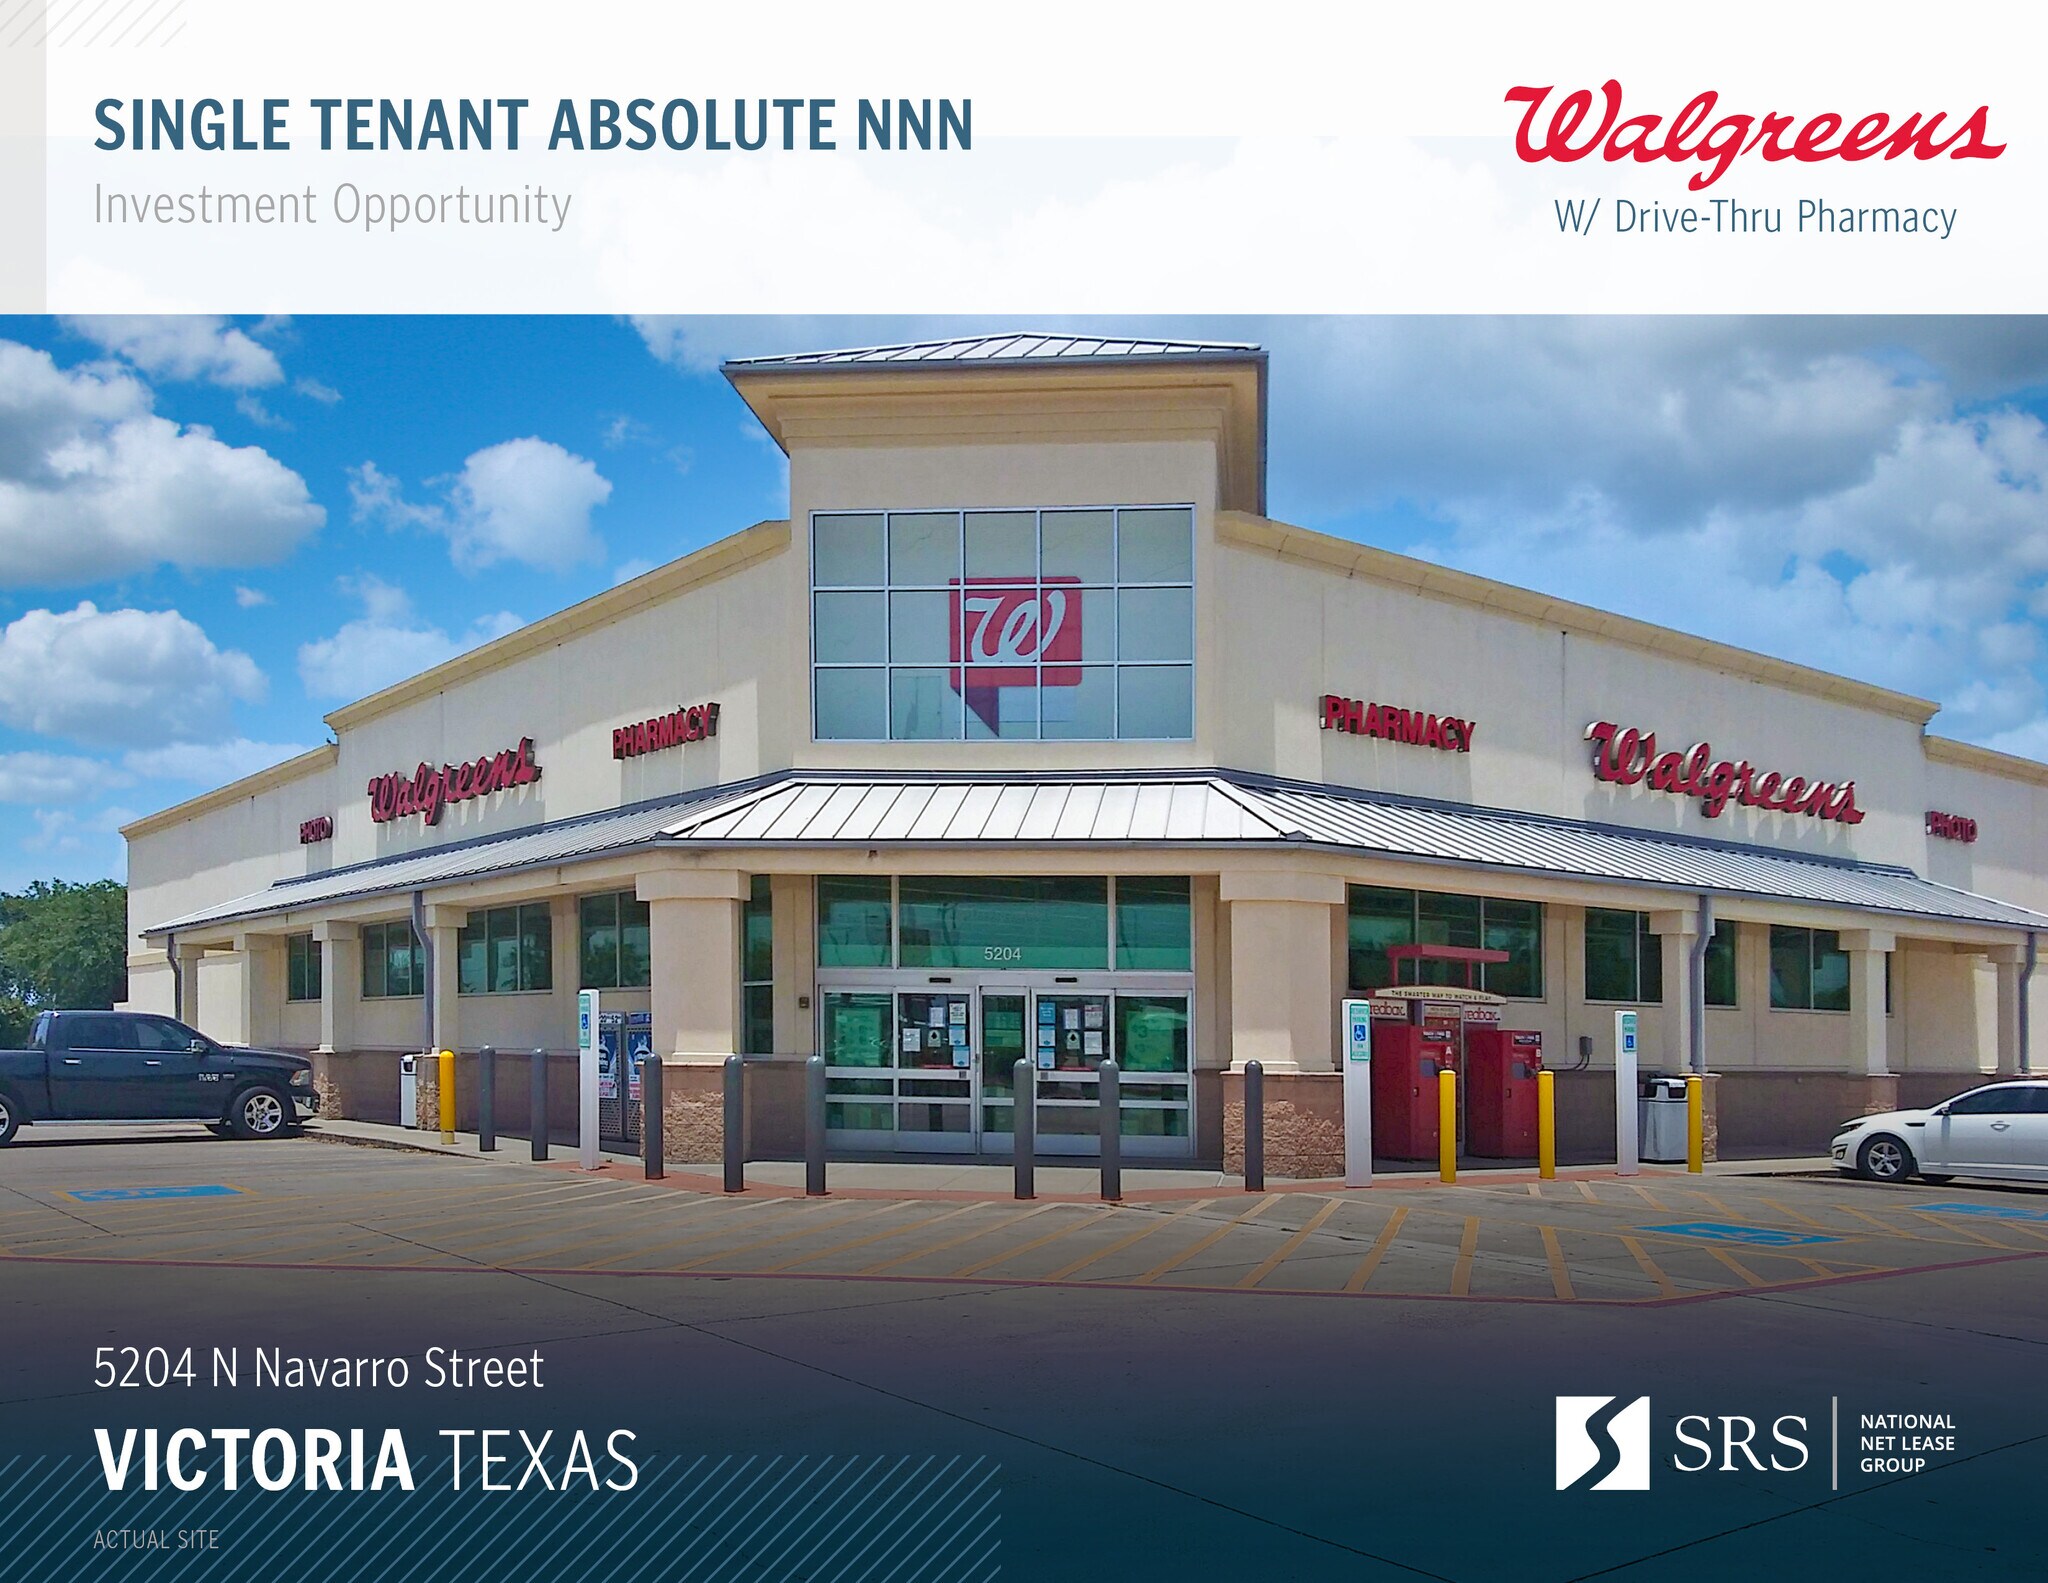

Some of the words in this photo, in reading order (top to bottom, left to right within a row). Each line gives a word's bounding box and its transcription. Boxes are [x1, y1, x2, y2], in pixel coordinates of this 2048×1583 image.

[613, 702, 720, 760] PHARMACY
[1320, 695, 1476, 752] PHARMACY
[368, 736, 542, 826] Walgreens
[1584, 721, 1866, 824] Walgreens
[300, 816, 333, 844] PHOTO
[1925, 811, 1978, 842] PHOTO
[984, 947, 1021, 961] 5204
